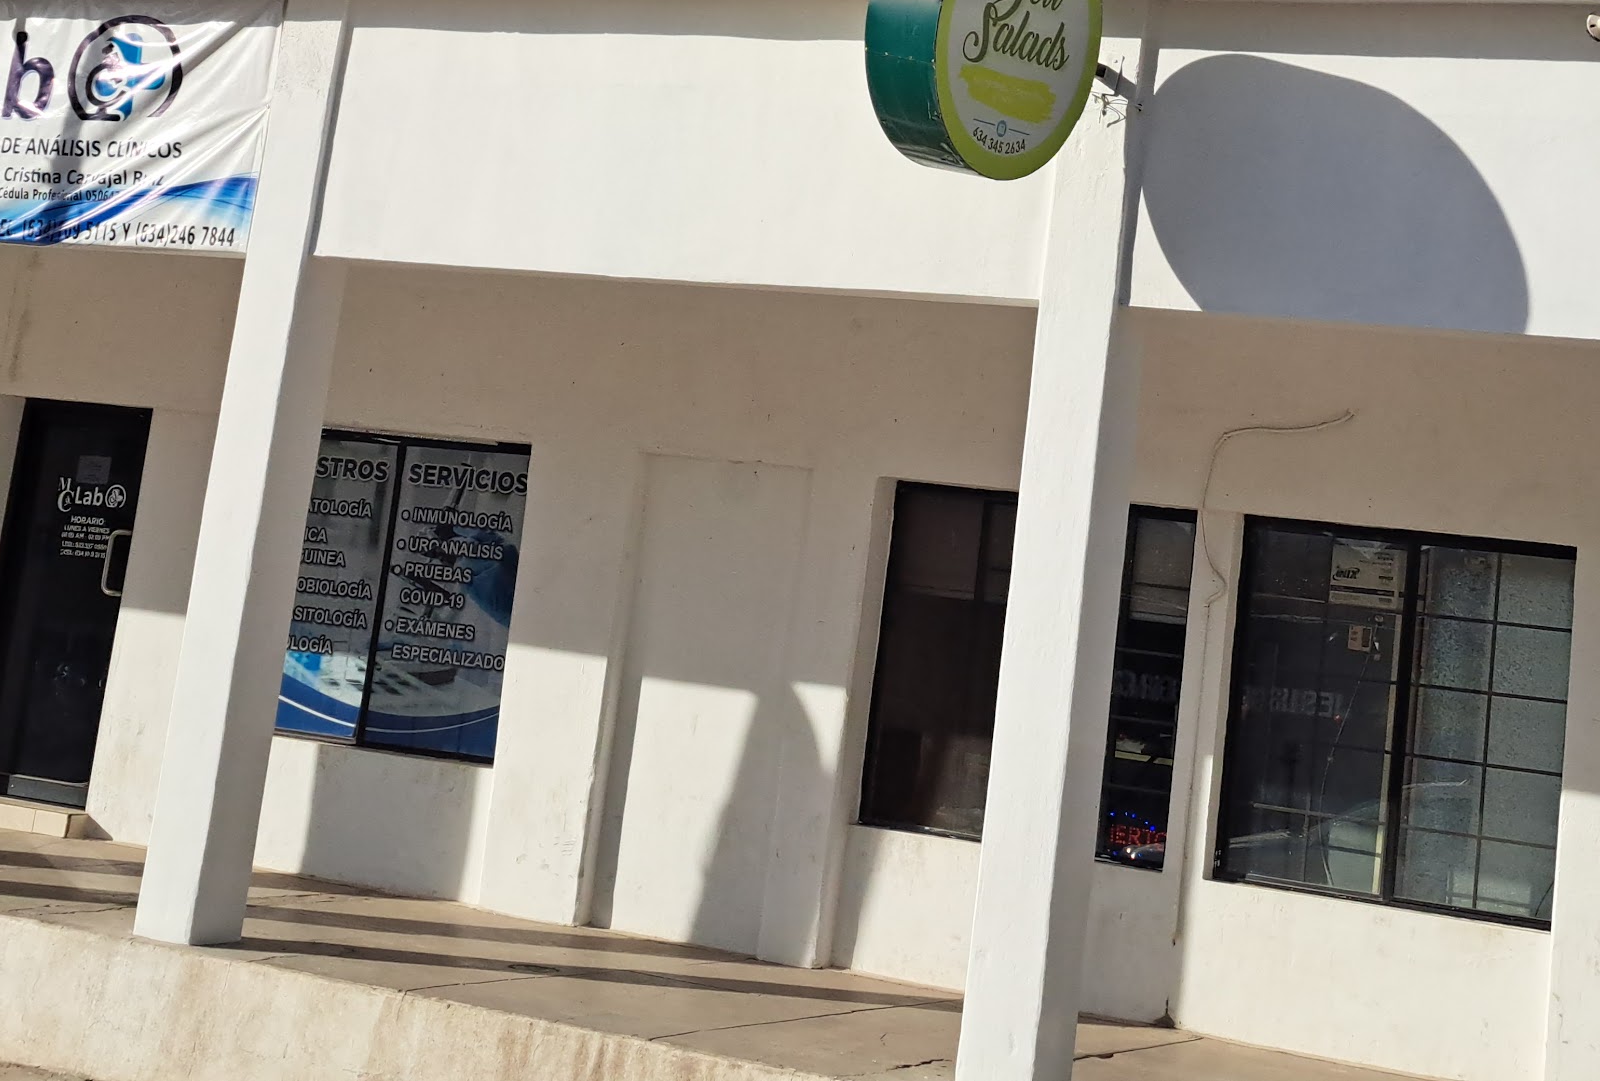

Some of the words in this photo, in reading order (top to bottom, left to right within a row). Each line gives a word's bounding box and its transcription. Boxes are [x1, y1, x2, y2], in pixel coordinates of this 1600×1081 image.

[963, 2, 1070, 71] Salads
[1, 136, 21, 155] DE
[25, 129, 102, 158] ANÁLISIS
[107, 136, 182, 159] CLÍNOS
[973, 126, 988, 147] 634
[988, 137, 1005, 153] 345
[1005, 138, 1026, 154] 2634
[4, 167, 62, 185] Cristina
[122, 223, 131, 241] Y
[200, 226, 236, 246] 7844
[407, 463, 527, 497] SERVICIOS
[75, 486, 103, 506] Lab
[70, 515, 105, 525] HORARIO
[412, 507, 513, 532] INMUNOLOGÍA
[404, 562, 472, 584] PRUEBAS
[400, 588, 465, 610] COVID-19
[396, 615, 476, 641] EXÁMENES
